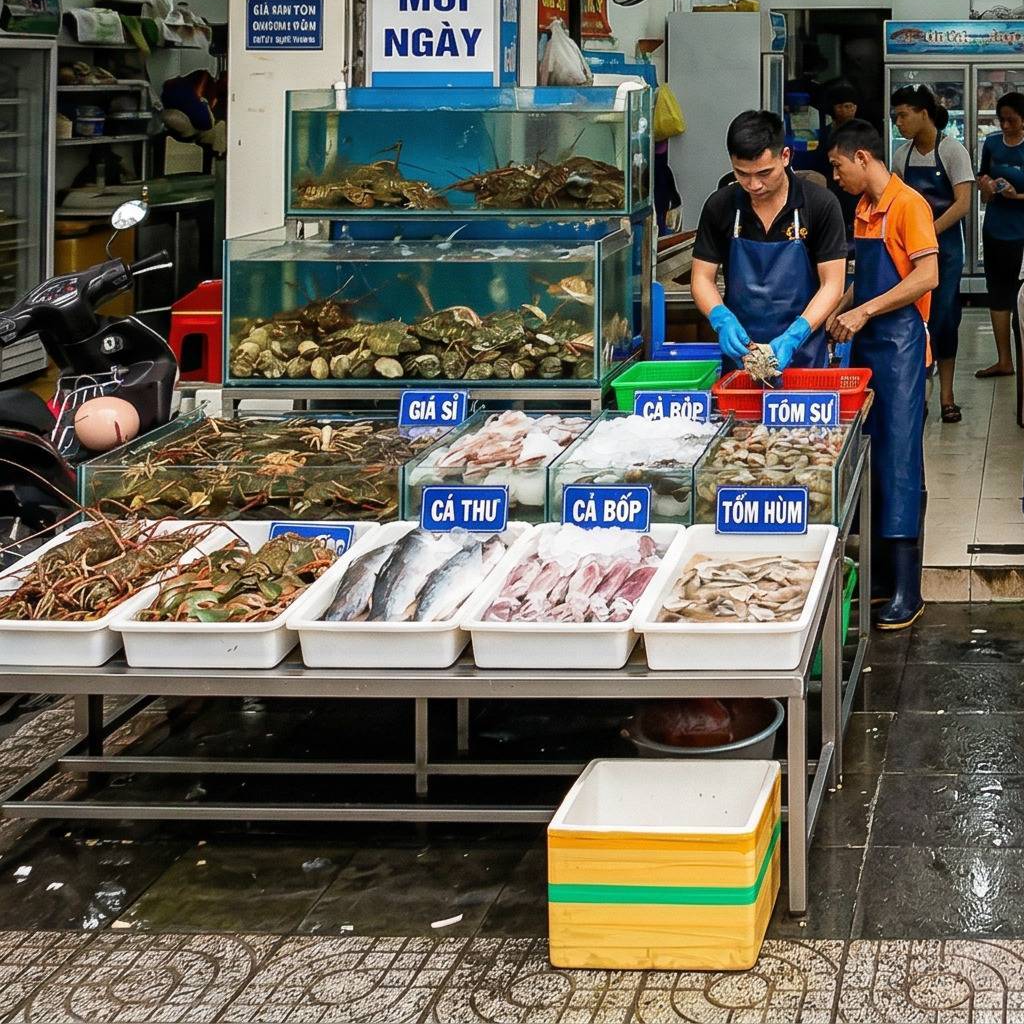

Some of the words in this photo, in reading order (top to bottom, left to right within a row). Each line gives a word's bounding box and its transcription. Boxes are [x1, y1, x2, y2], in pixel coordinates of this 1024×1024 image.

[383, 25, 483, 58] NGÀY
[408, 395, 436, 421] GIÁ
[440, 392, 459, 421] SỈ
[430, 493, 456, 522] CÁ
[461, 497, 501, 522] THƯ
[603, 491, 642, 522] BỐP
[763, 495, 803, 524] HÙM
